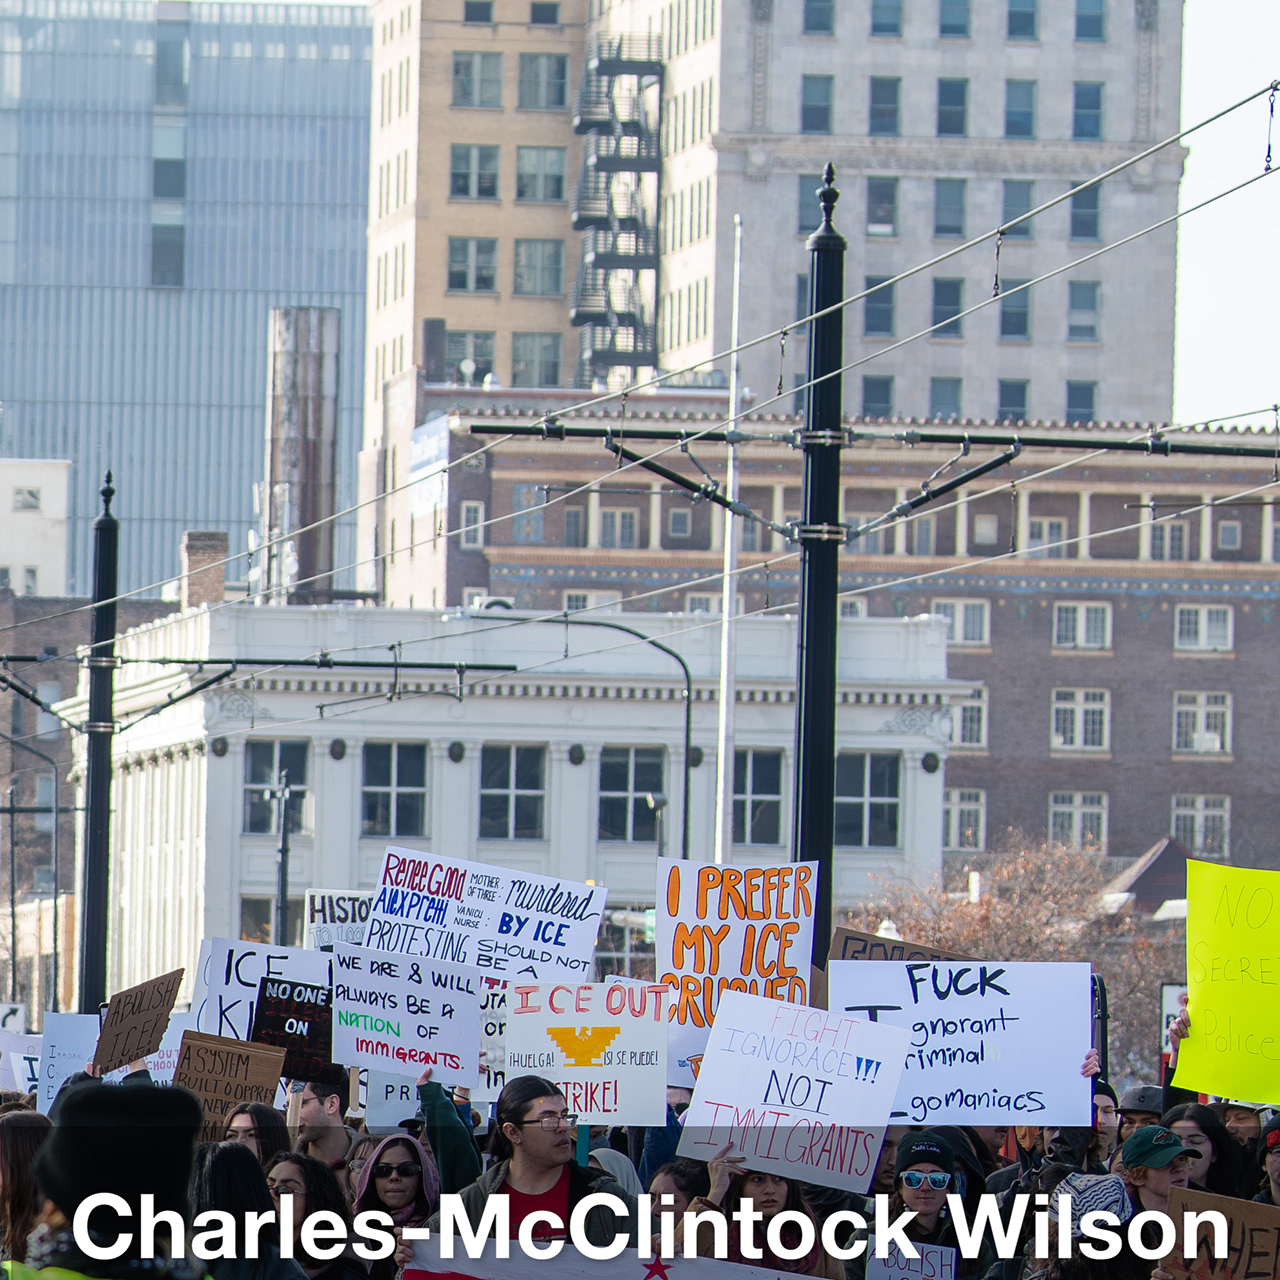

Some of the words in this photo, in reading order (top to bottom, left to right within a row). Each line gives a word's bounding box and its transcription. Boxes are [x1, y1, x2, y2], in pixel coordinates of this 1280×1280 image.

[382, 853, 428, 893] Renee
[667, 865, 681, 917] I
[696, 865, 812, 920] PREFER
[1213, 884, 1274, 930] NO
[366, 918, 471, 964] PROTESTING
[497, 911, 531, 938] BY
[532, 919, 572, 948] ICE
[672, 922, 731, 976] MY
[740, 922, 800, 978] ICE
[337, 953, 363, 971] WE
[369, 960, 401, 979] ARE
[431, 970, 477, 996] WILL
[476, 953, 510, 971] BE
[516, 965, 539, 980] A
[477, 938, 553, 963] SHOULD
[555, 955, 592, 973] NOT
[109, 976, 179, 1028] ABOLISH
[406, 994, 431, 1016] BE
[513, 985, 593, 1015] ICE
[606, 984, 670, 1022] OUT
[905, 962, 1011, 1005] FUCK
[284, 1017, 310, 1037] ON
[416, 1024, 440, 1040] OF
[771, 1006, 860, 1049] FIGHT
[763, 1069, 833, 1113] NOT
[693, 1100, 875, 1178] IMMIGRANTS
